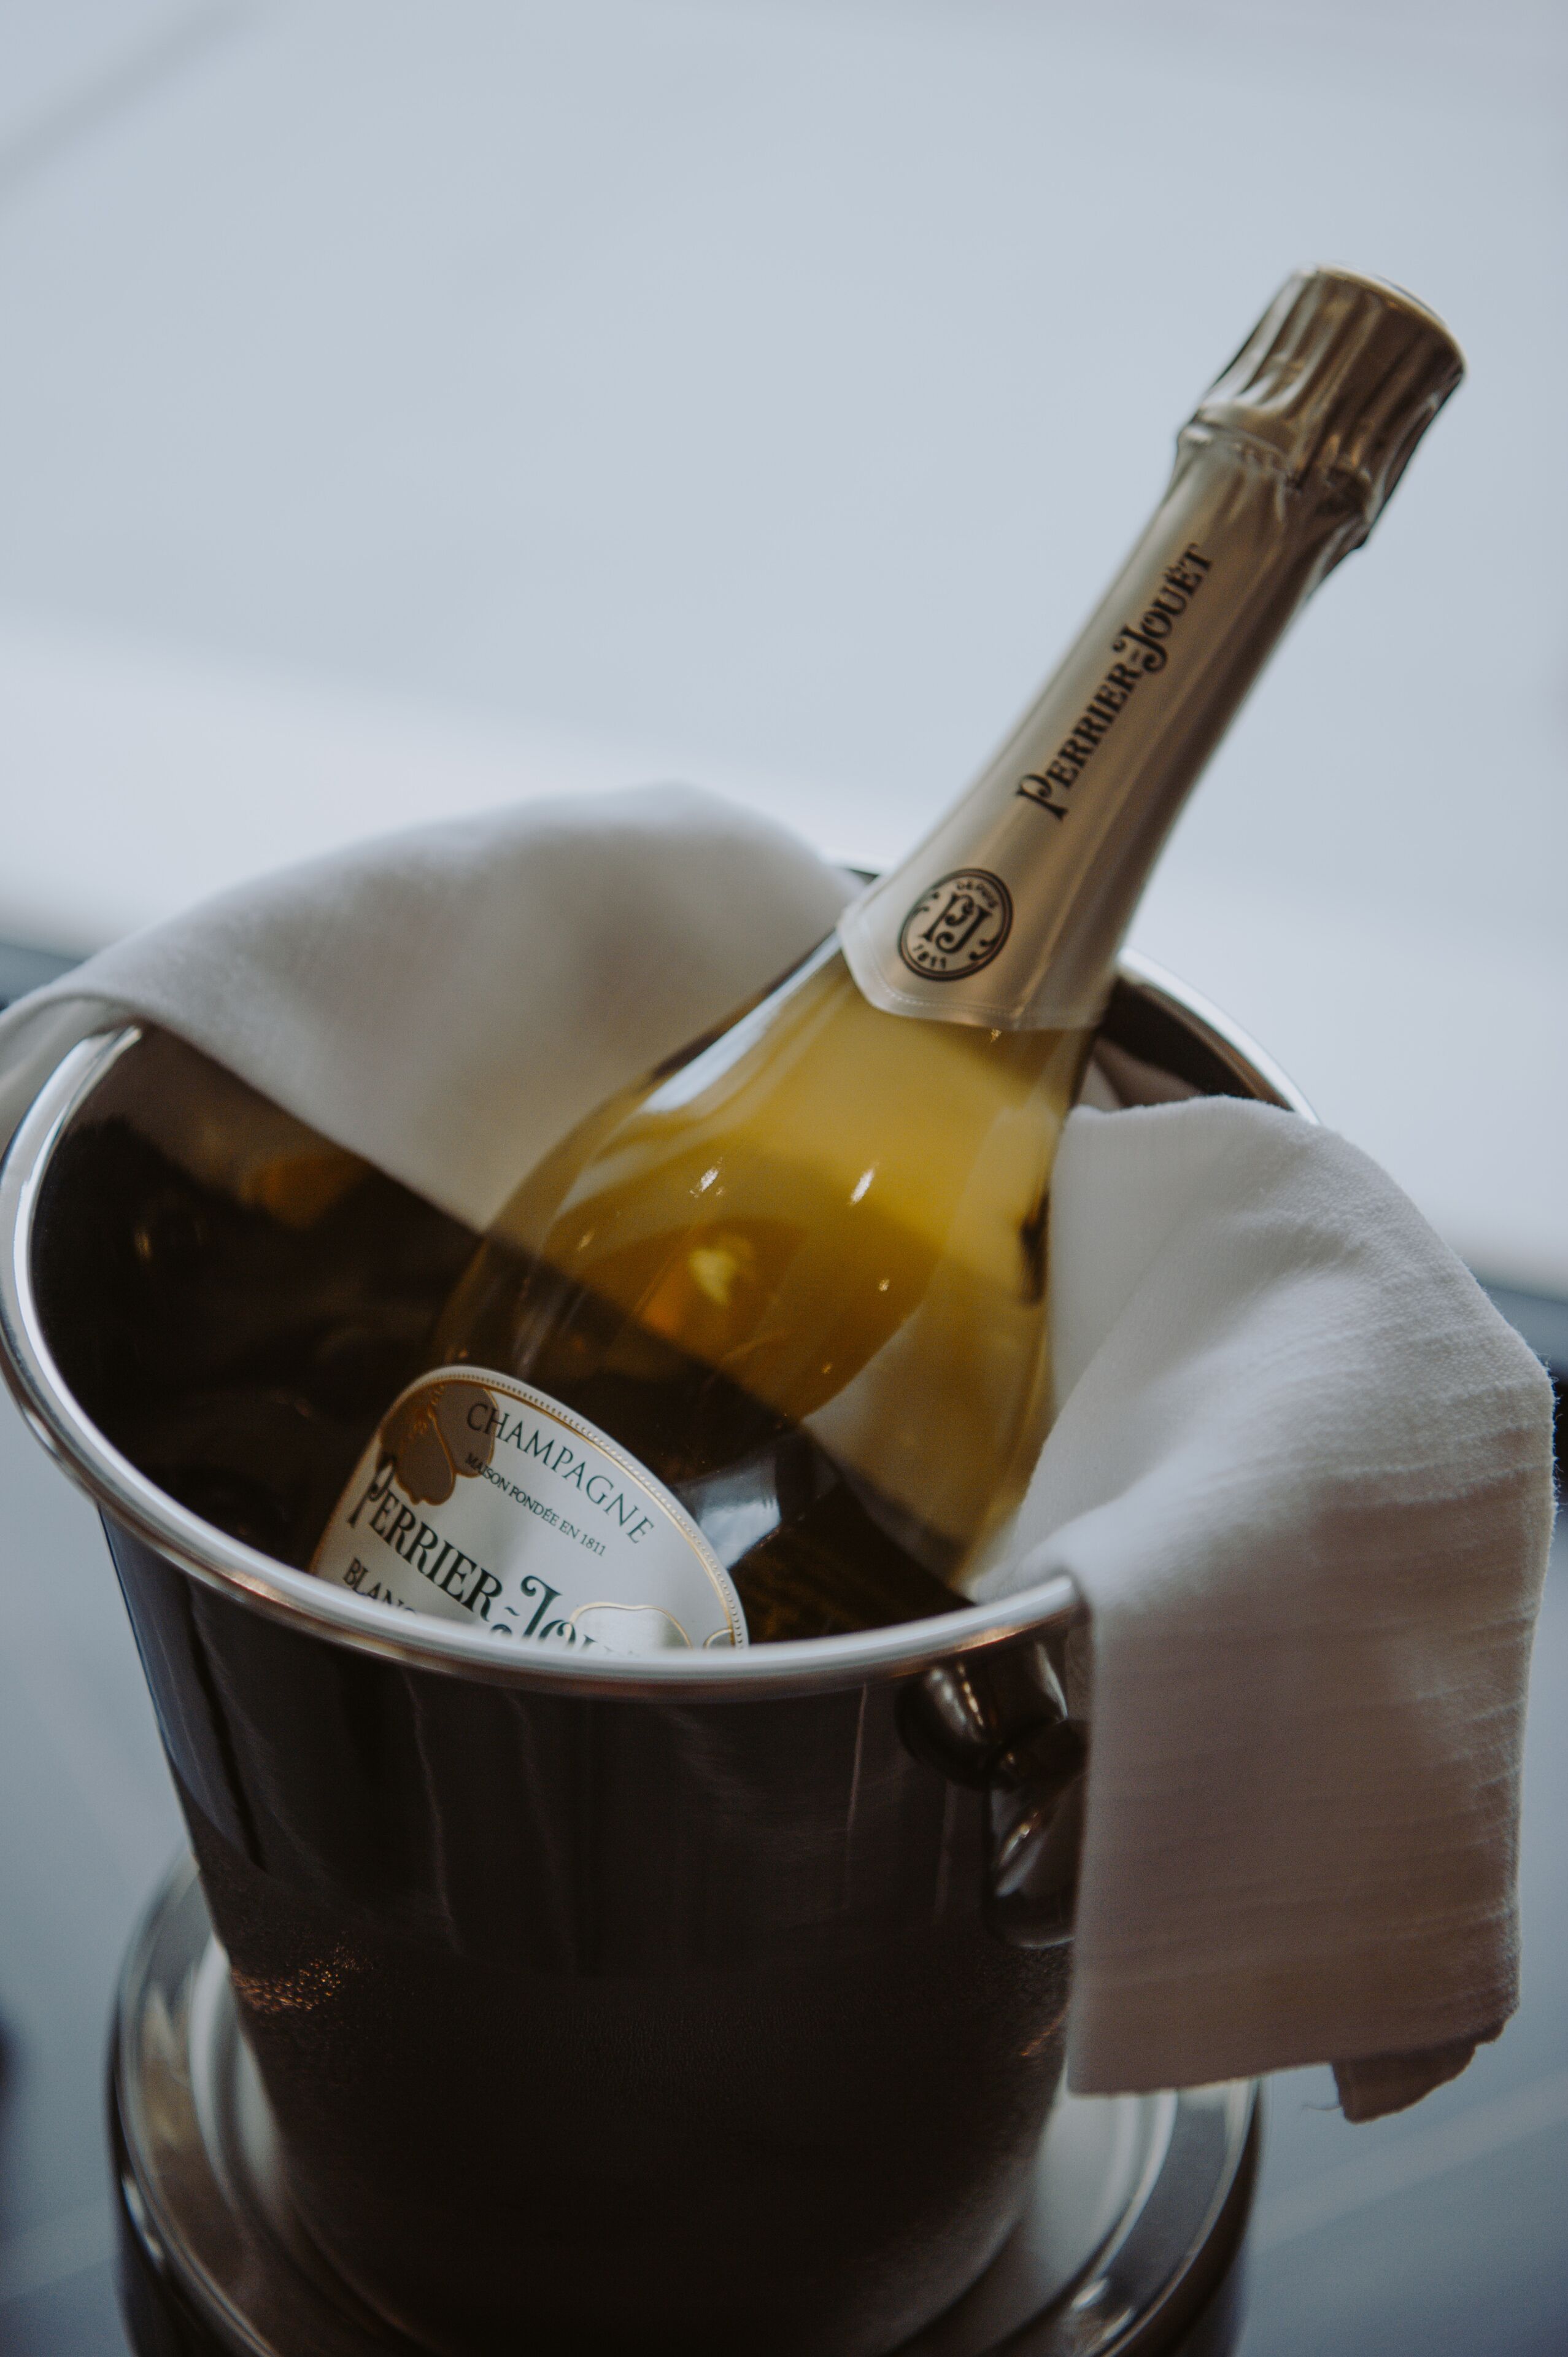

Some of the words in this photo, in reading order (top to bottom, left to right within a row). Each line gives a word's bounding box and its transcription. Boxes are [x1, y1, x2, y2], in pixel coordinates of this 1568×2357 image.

[465, 1453, 511, 1492] MAISON
[509, 1485, 560, 1527] FONDÉE
[558, 1520, 581, 1539] EN
[580, 1534, 606, 1557] 1811
[466, 1403, 655, 1544] CHAMPAGNE
[342, 1557, 416, 1614] BLA
[347, 1452, 617, 1652] PERRIER-JO
